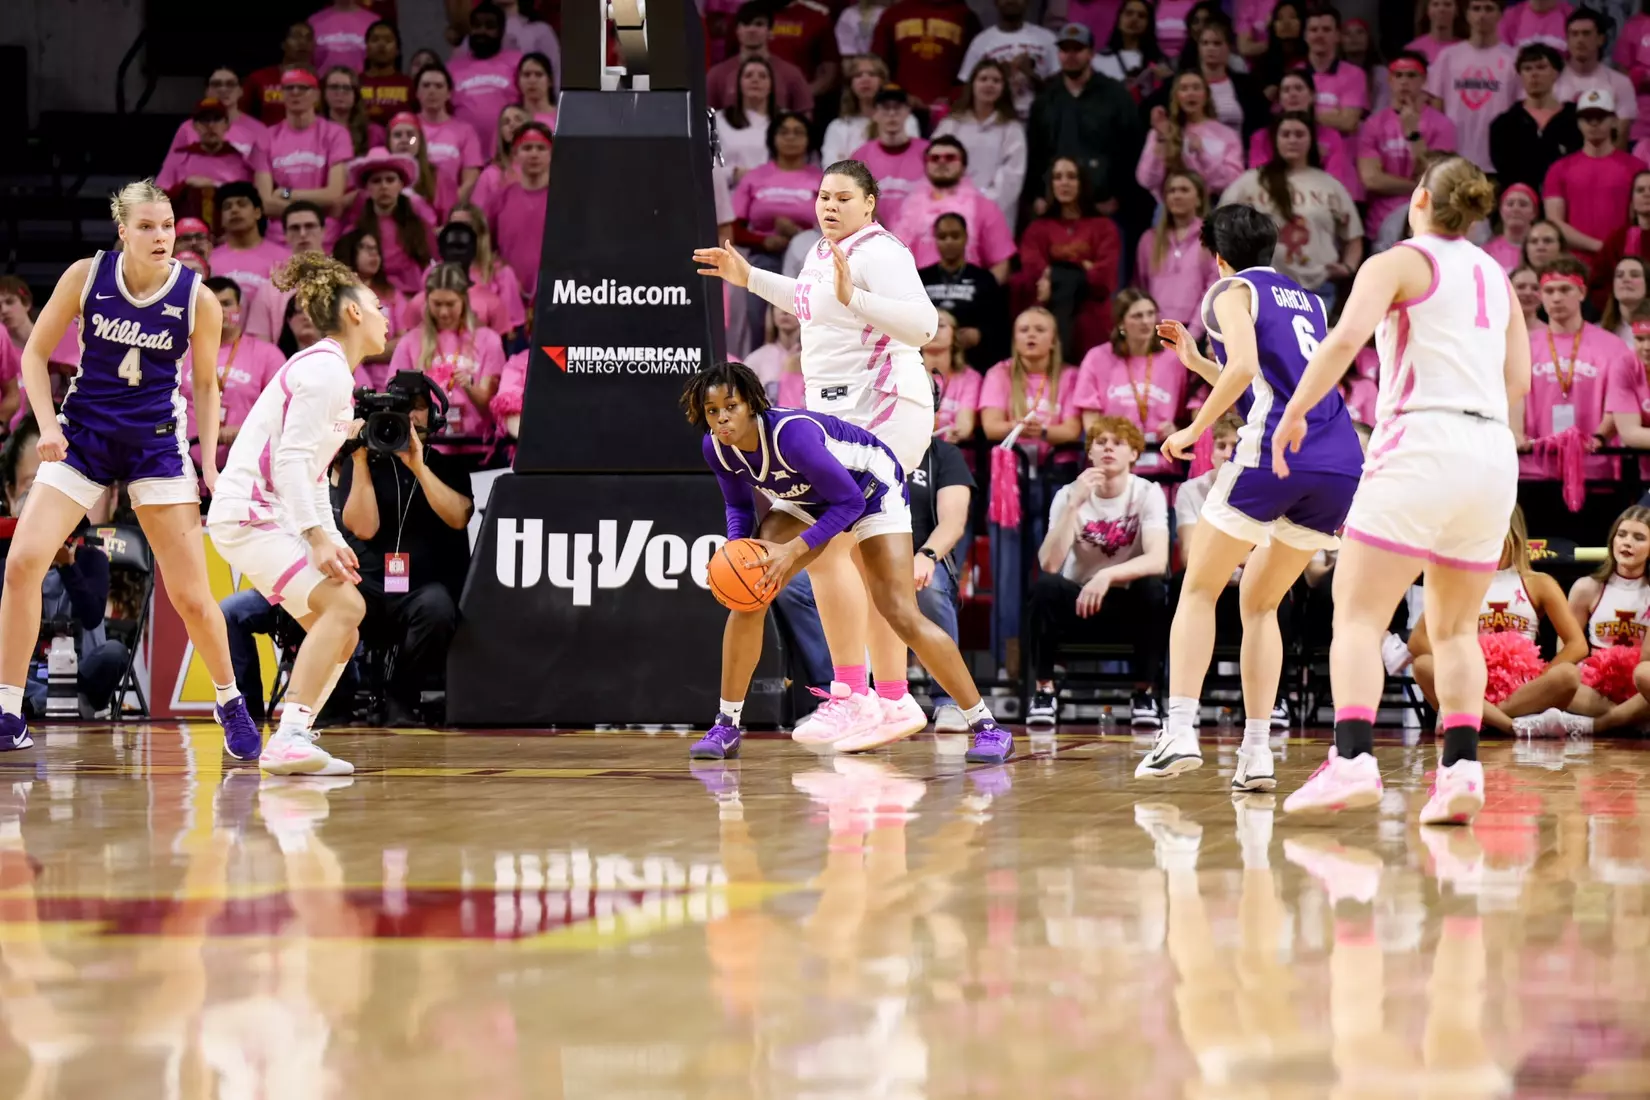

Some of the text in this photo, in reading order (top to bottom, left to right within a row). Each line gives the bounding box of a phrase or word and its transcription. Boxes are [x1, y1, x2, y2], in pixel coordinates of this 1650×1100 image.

[794, 283, 812, 320] 55
[1271, 285, 1313, 313] GARCIA
[1473, 263, 1490, 328] 1
[92, 313, 173, 350] Wildcats
[1291, 314, 1320, 362] 6
[118, 347, 142, 387] 4
[567, 346, 701, 362] MIDAMERICAN
[567, 361, 623, 373] ENERGY
[912, 469, 927, 487] E
[1478, 612, 1529, 632] TATE
